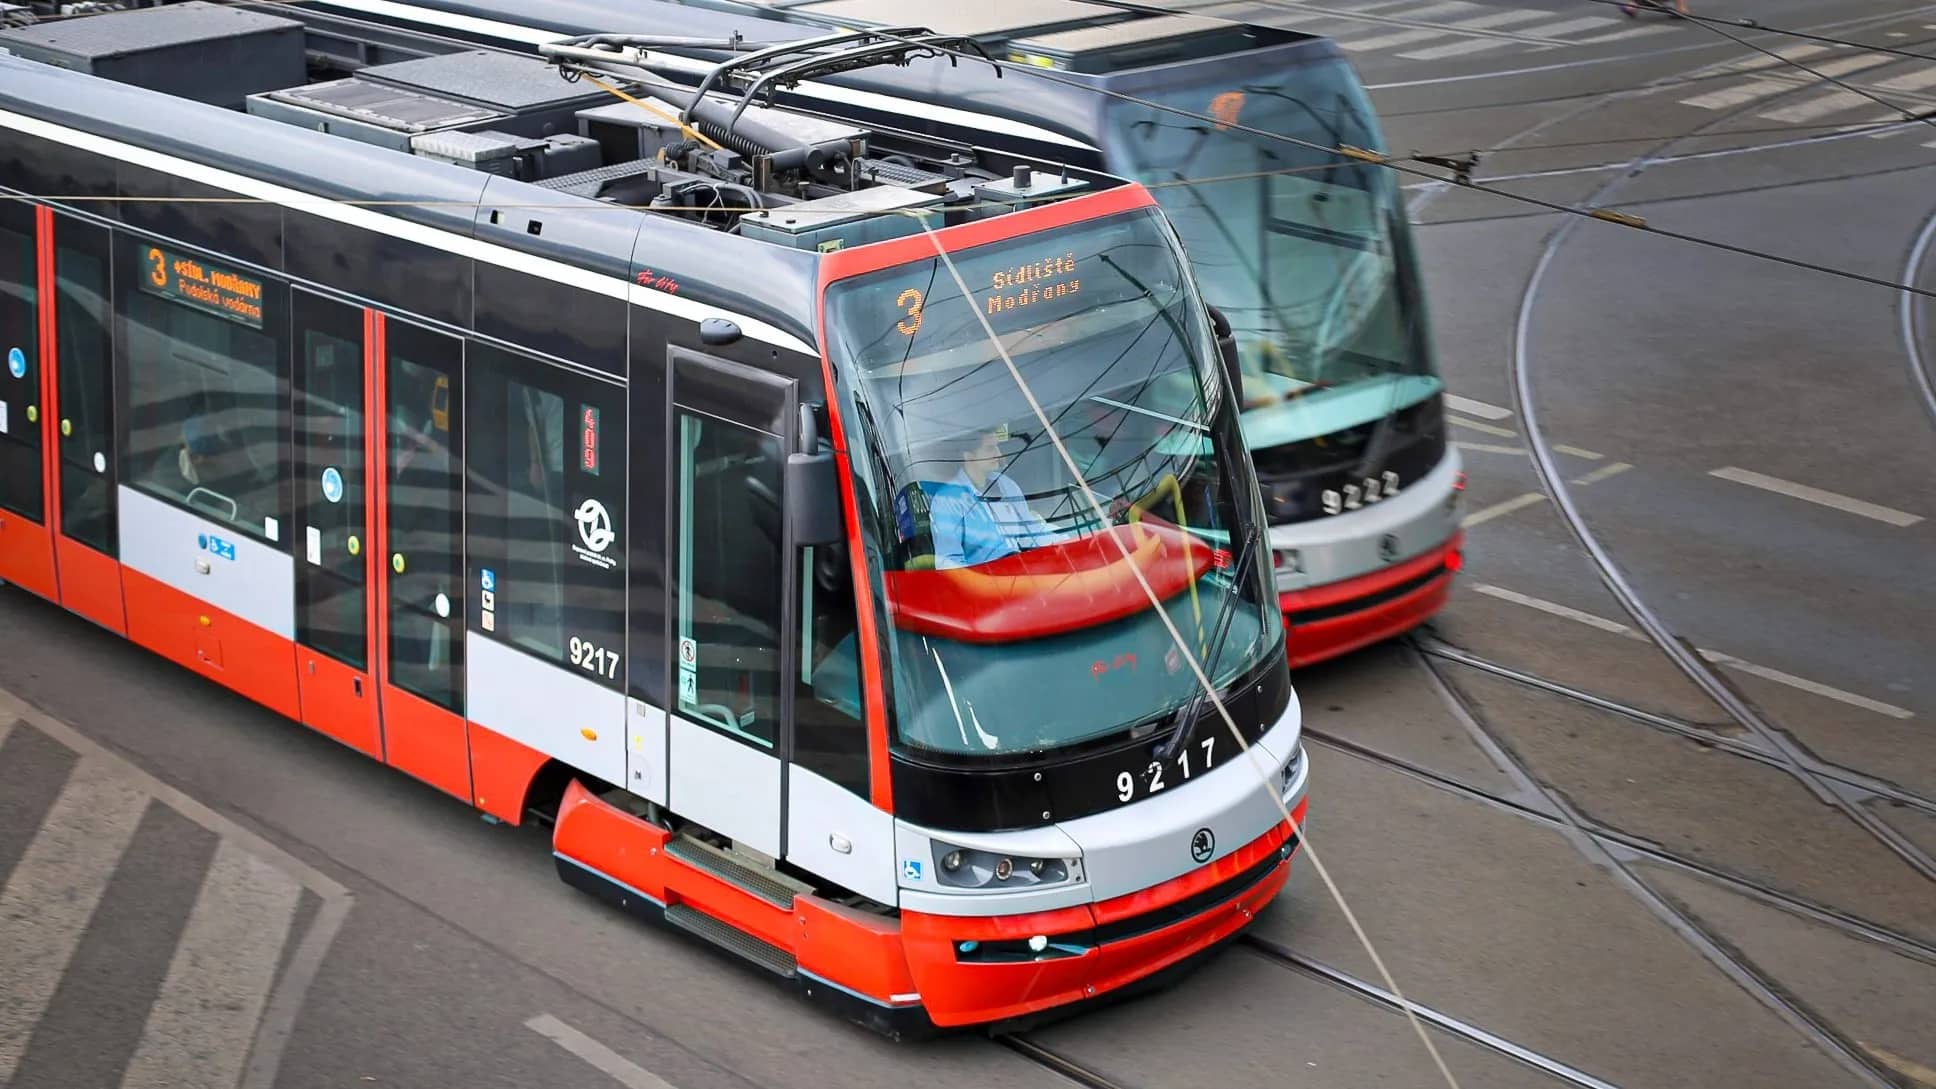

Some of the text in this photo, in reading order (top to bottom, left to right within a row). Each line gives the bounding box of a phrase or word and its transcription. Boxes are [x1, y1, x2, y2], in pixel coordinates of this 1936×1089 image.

[148, 248, 167, 287] 3
[993, 252, 1076, 291] Sídliště
[896, 288, 923, 336] 3
[987, 279, 1080, 314] Modřany
[1321, 470, 1401, 515] 9222
[569, 636, 620, 680] 9217
[1116, 736, 1216, 802] 9217
